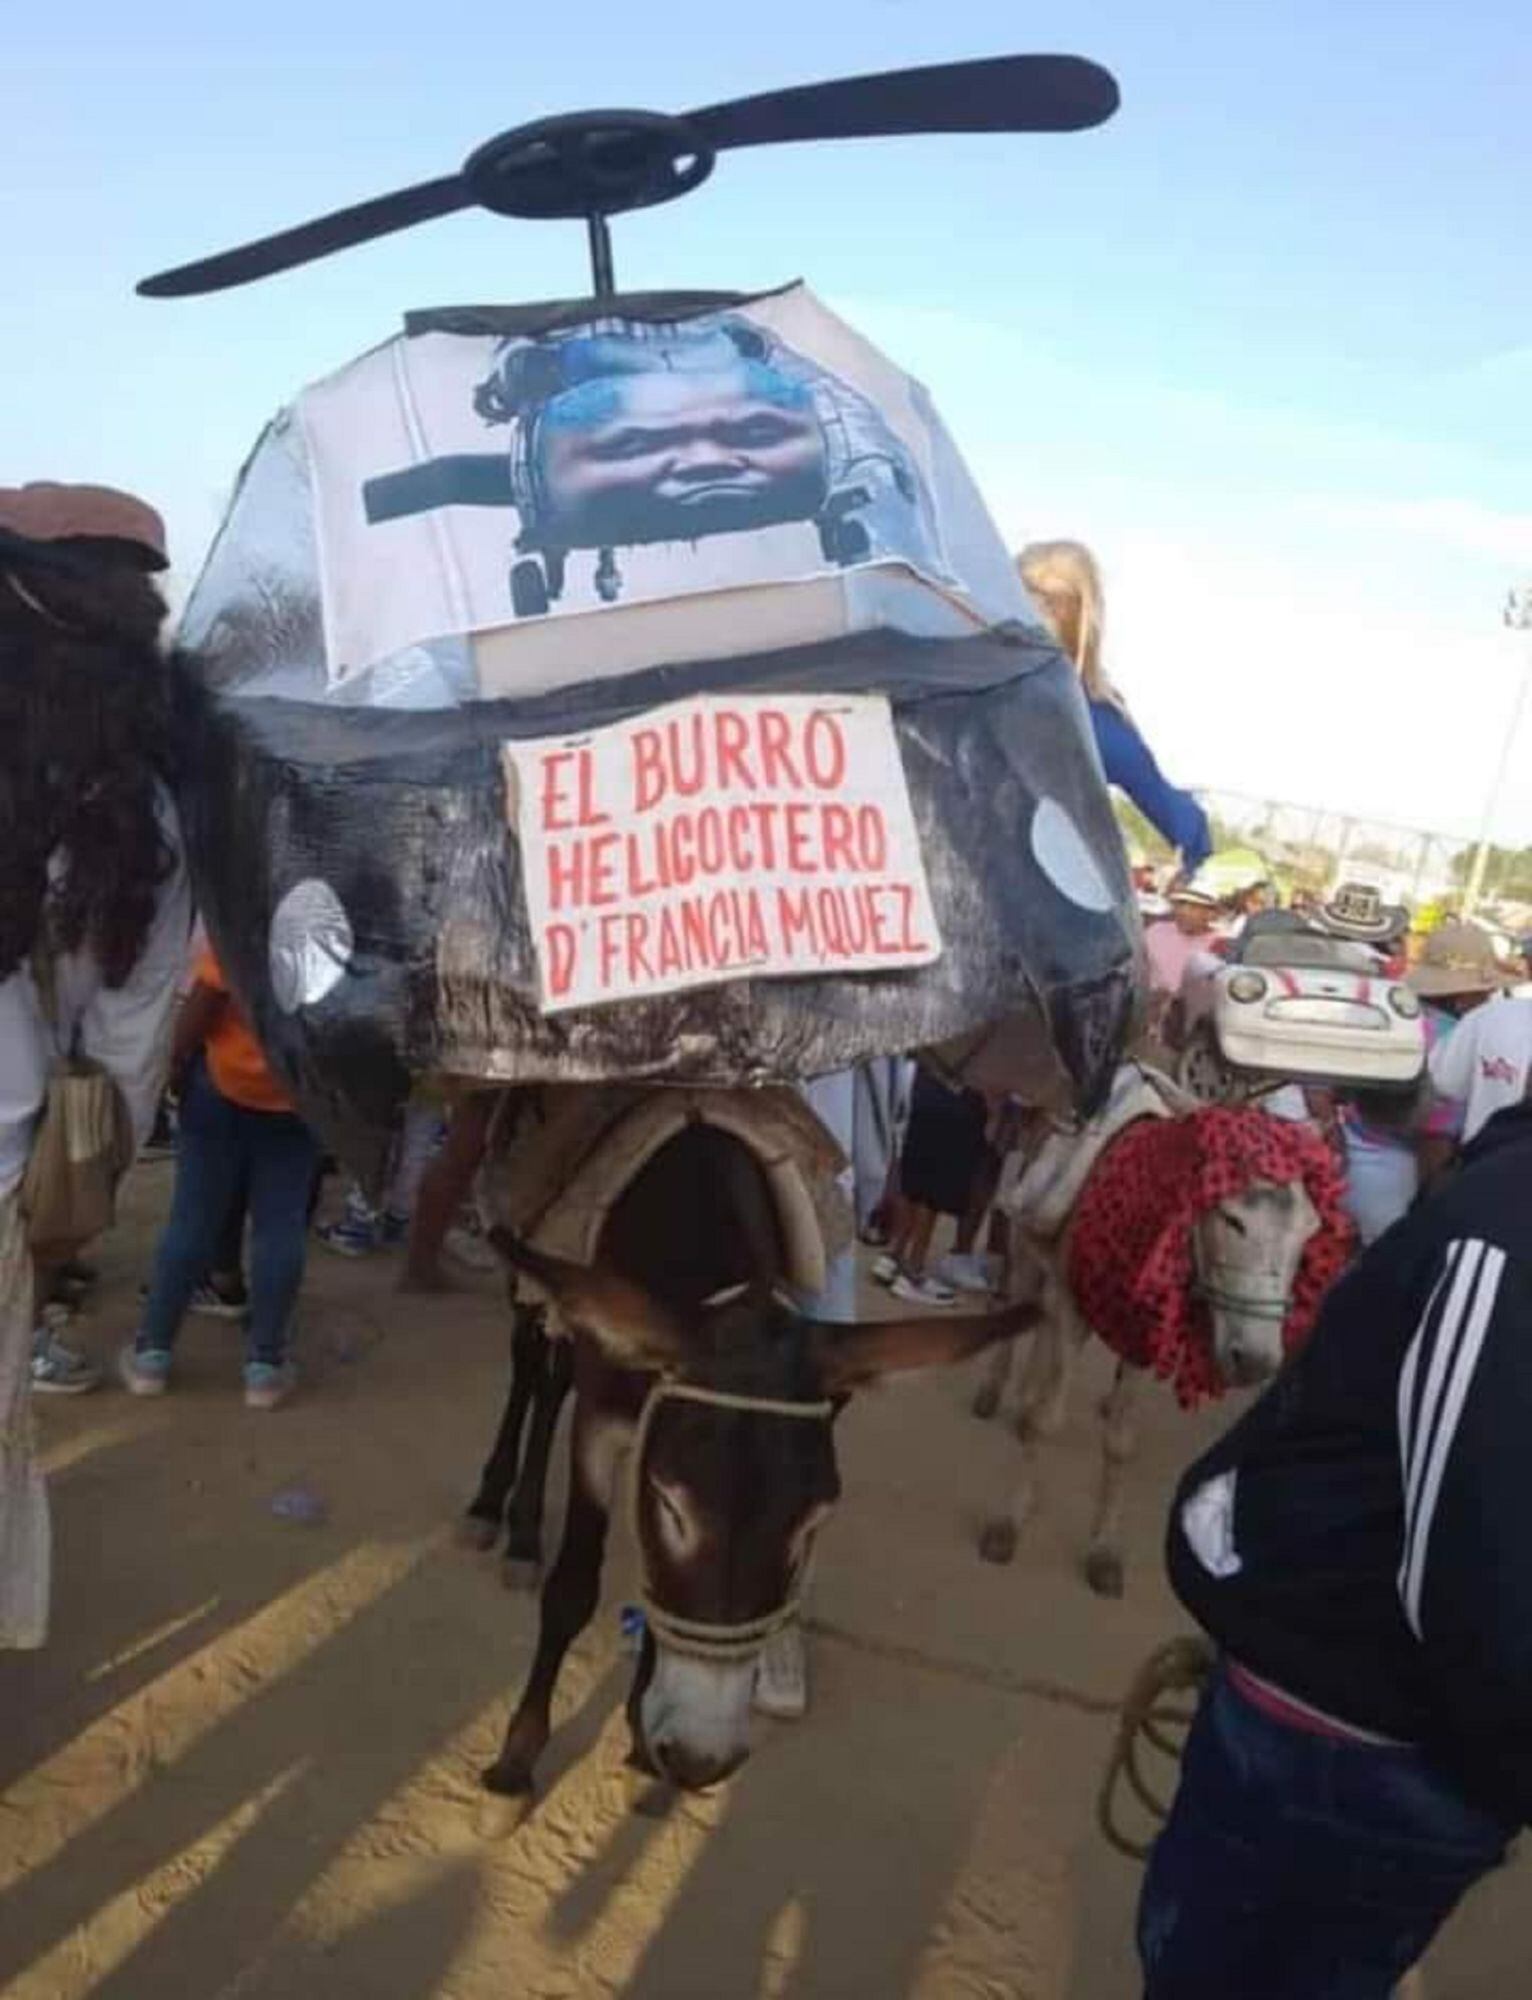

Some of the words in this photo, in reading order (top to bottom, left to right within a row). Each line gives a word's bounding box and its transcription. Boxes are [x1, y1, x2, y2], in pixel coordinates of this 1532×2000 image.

[541, 748, 611, 831] EL
[630, 709, 846, 814] BURRO
[546, 803, 888, 911] HELICOCTERO
